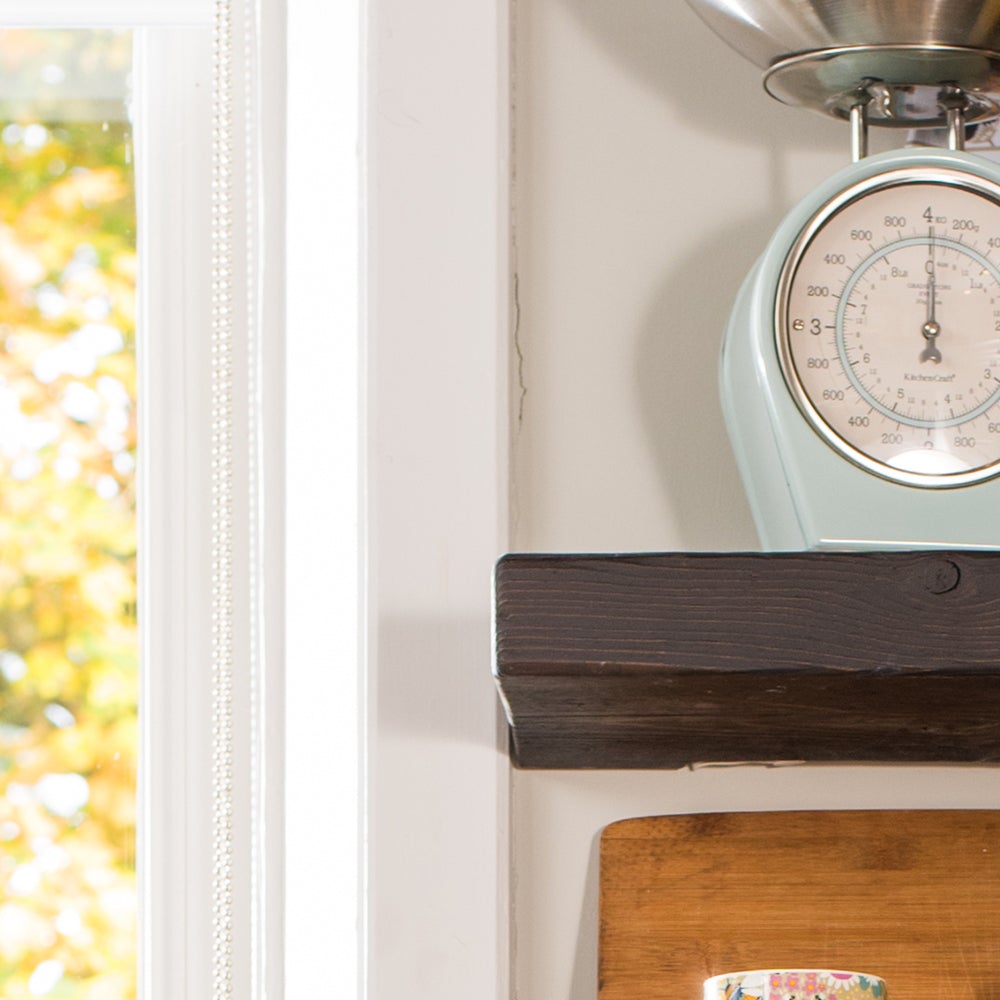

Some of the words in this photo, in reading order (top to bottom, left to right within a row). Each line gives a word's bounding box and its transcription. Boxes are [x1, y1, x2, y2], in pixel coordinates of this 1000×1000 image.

[922, 206, 933, 222] 4
[884, 216, 906, 227] 800
[850, 230, 872, 241] 600
[824, 254, 846, 265] 400
[807, 285, 829, 297] 200
[860, 304, 868, 315] 7
[810, 318, 821, 335] 3
[807, 358, 829, 369] 800
[863, 353, 870, 363] 6
[983, 369, 991, 379] 3
[822, 390, 844, 401] 600
[897, 388, 904, 399] 5
[944, 394, 951, 404] 4
[848, 416, 870, 427] 400
[881, 433, 903, 444] 200
[954, 437, 975, 448] 800
